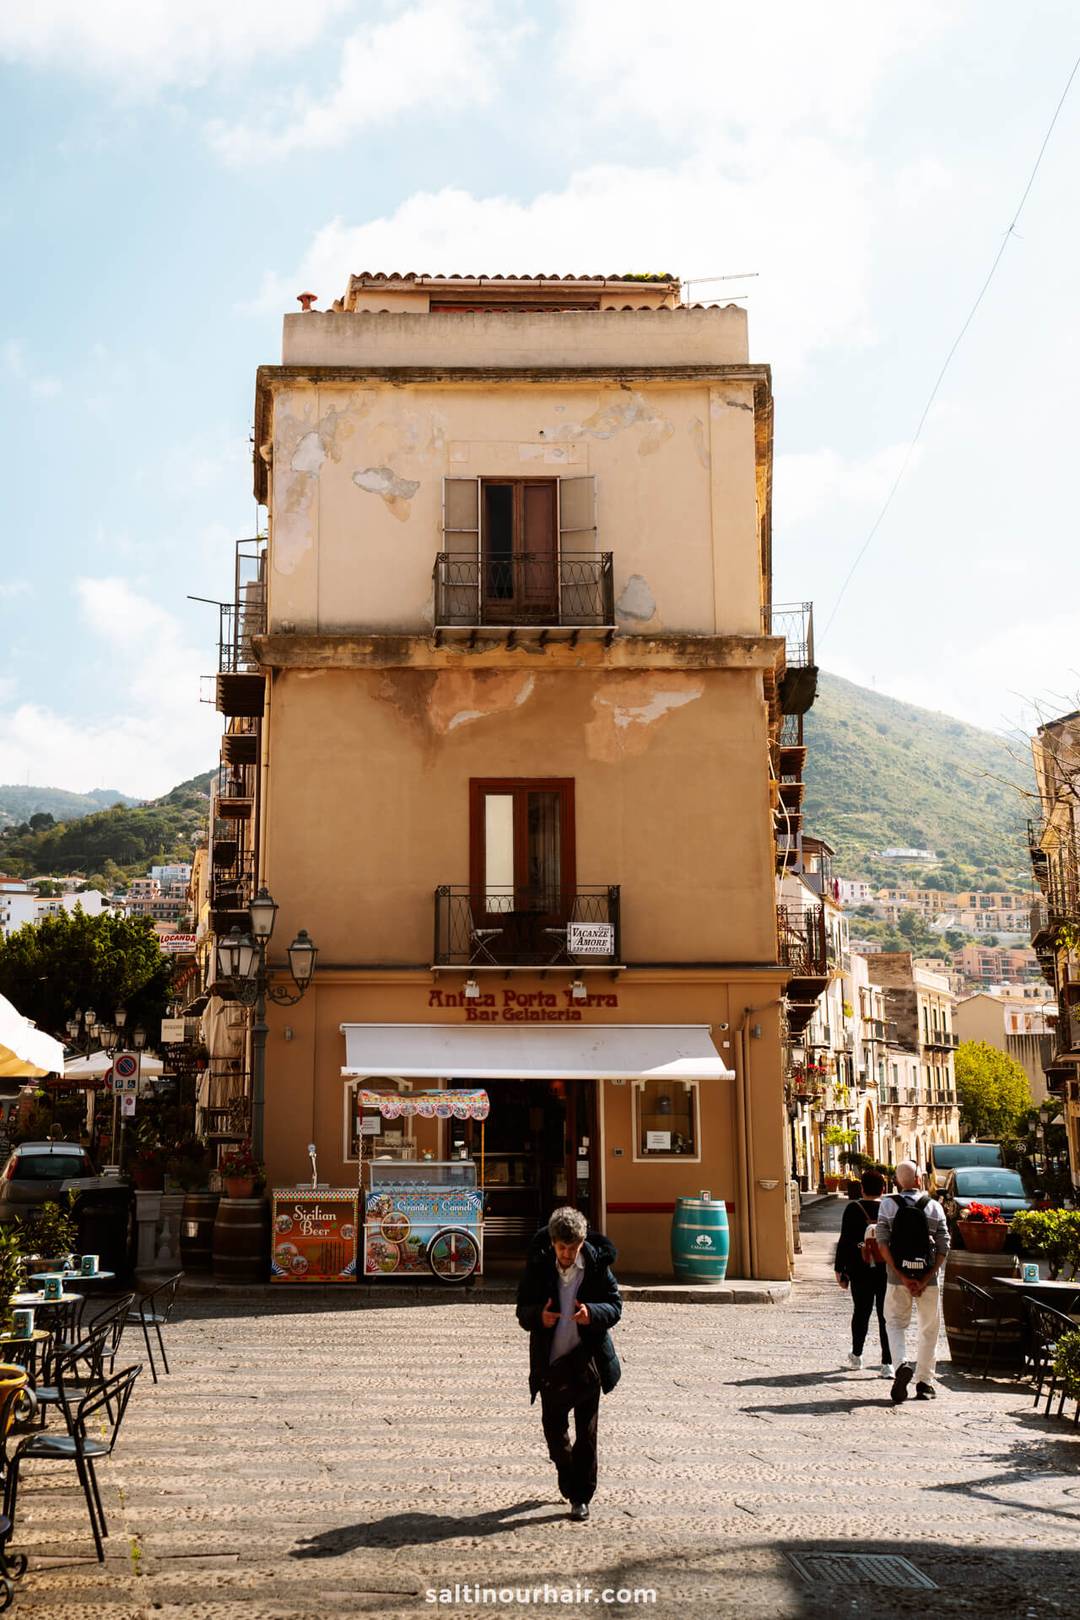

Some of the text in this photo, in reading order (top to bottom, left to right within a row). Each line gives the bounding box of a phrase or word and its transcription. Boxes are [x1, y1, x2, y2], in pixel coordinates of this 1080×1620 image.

[572, 927, 609, 938] VACANZE
[160, 935, 196, 943] LOCANDA
[576, 937, 608, 946] AMORE
[428, 990, 496, 1007] Antica
[502, 990, 557, 1007] Porta
[465, 1007, 582, 1021] Bar Gelateria
[293, 1204, 337, 1221] Sicilian
[299, 1219, 330, 1236] Beer
[902, 1259, 924, 1269] PUMA
